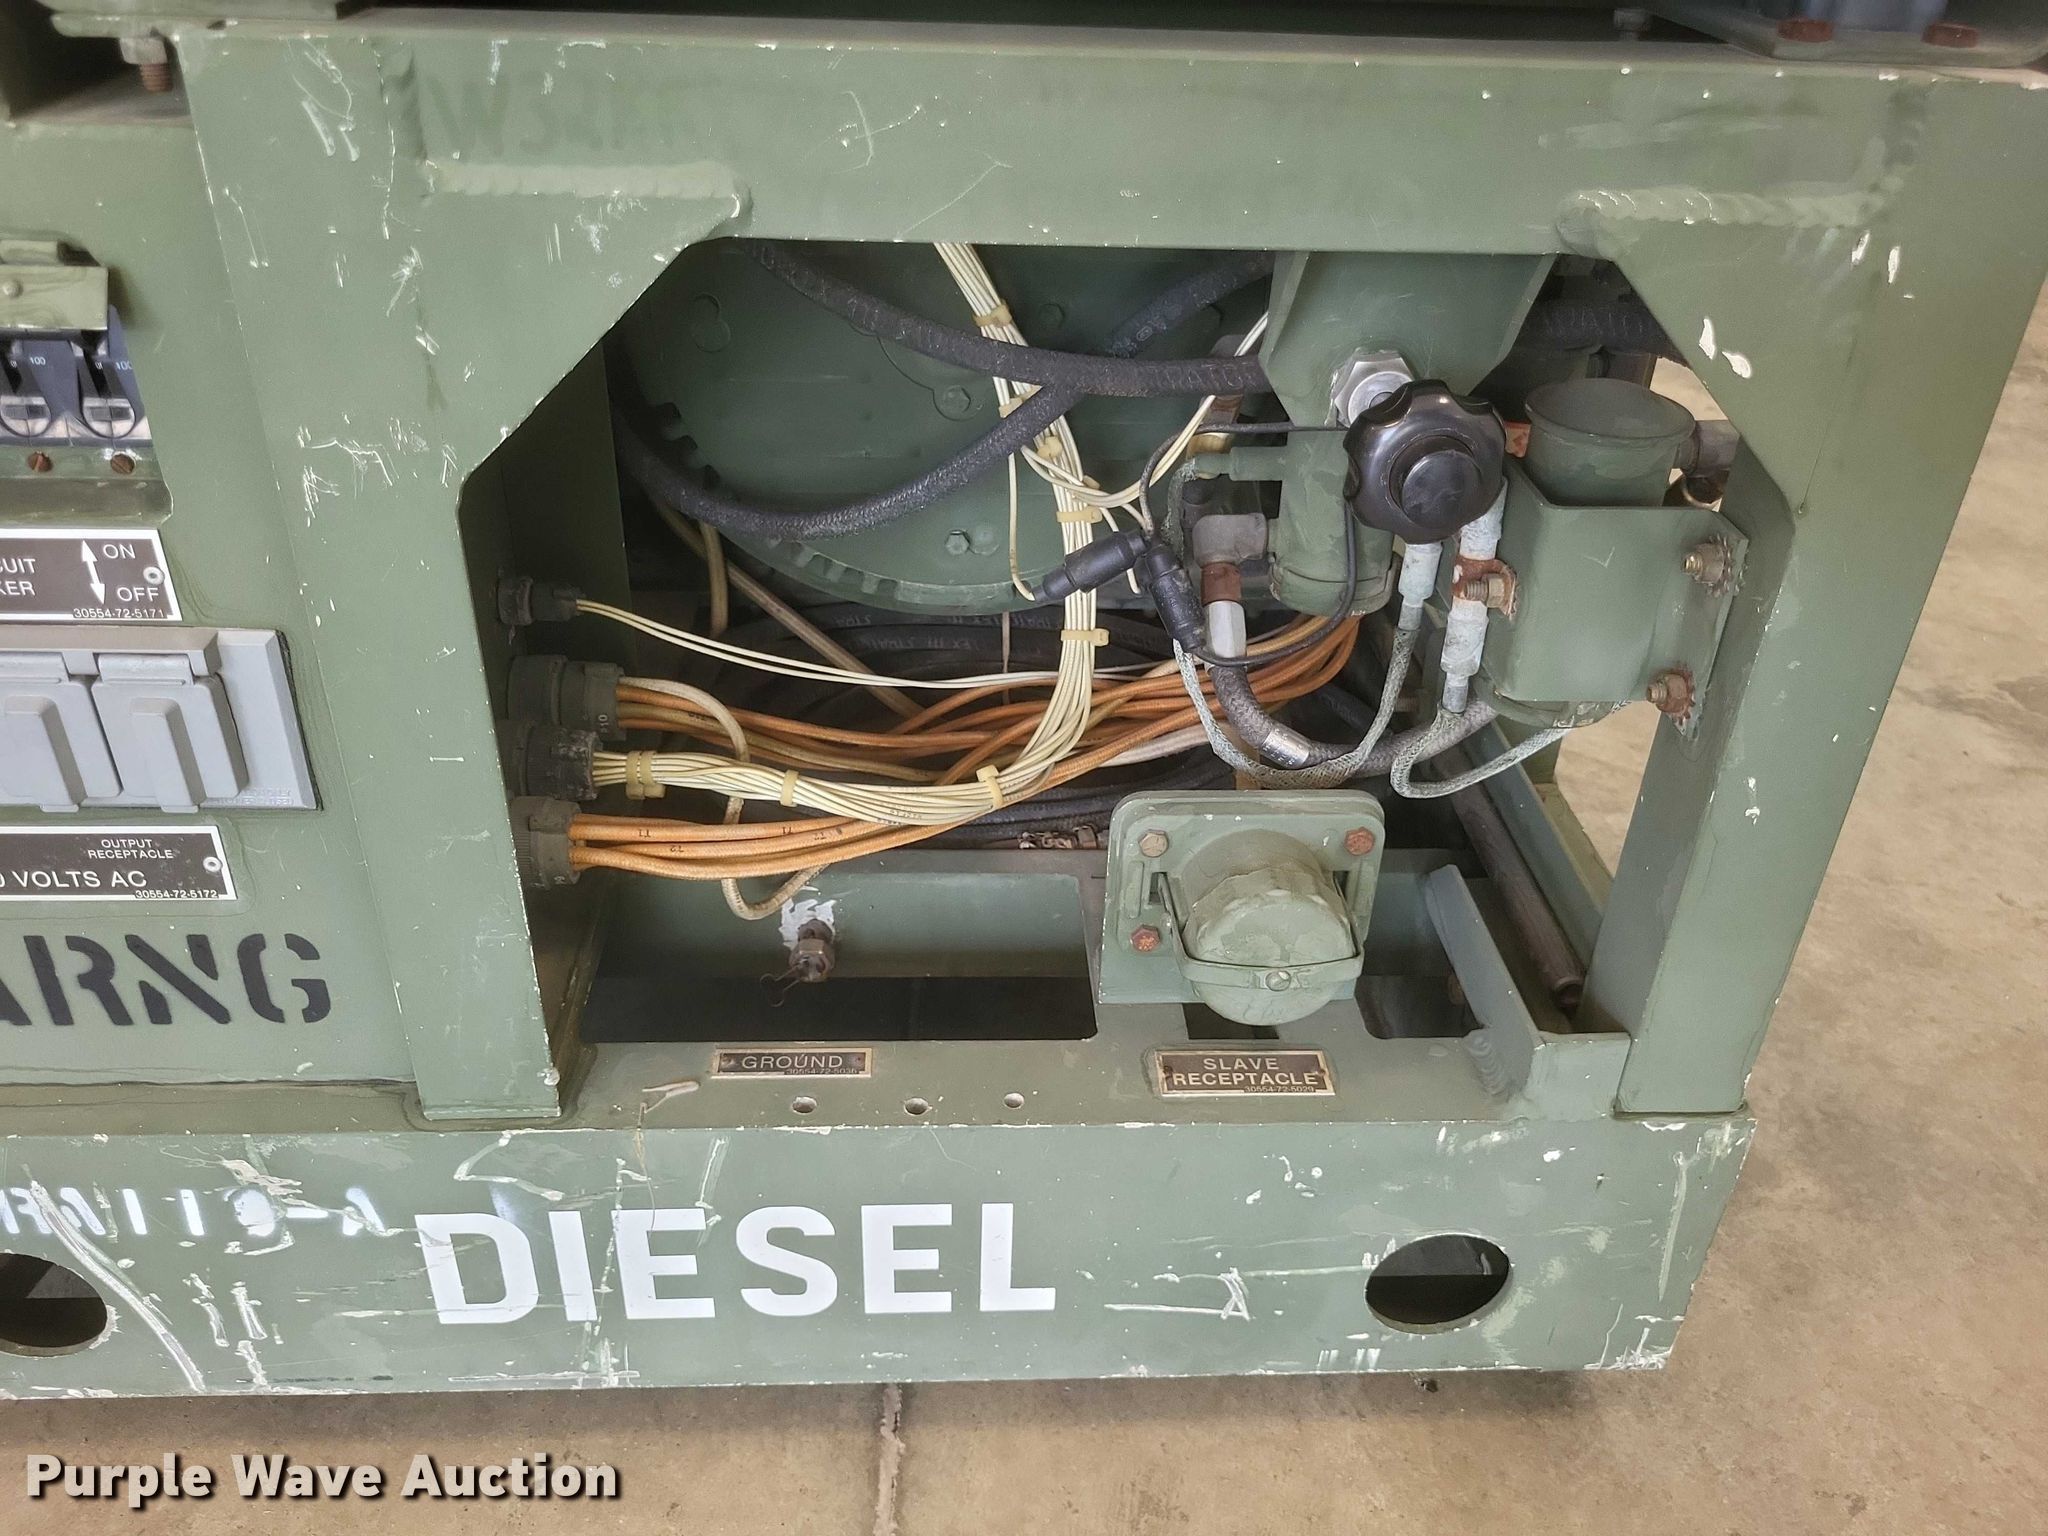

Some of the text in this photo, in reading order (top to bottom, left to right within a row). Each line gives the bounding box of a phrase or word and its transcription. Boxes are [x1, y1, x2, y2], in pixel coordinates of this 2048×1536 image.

[102, 543, 136, 559] ON
[117, 586, 160, 602] OFF
[73, 607, 165, 619] 30554-72-5171
[100, 839, 153, 848] OUTPUT
[88, 850, 174, 859] RECEPTACLE
[12, 871, 101, 888] VOLTS
[111, 871, 148, 888] AC
[742, 1055, 843, 1069] GROUND
[1203, 1057, 1280, 1070] SLAVE
[1173, 1072, 1319, 1086] RECEPTACLE
[414, 1203, 1056, 1324] DIESEL
